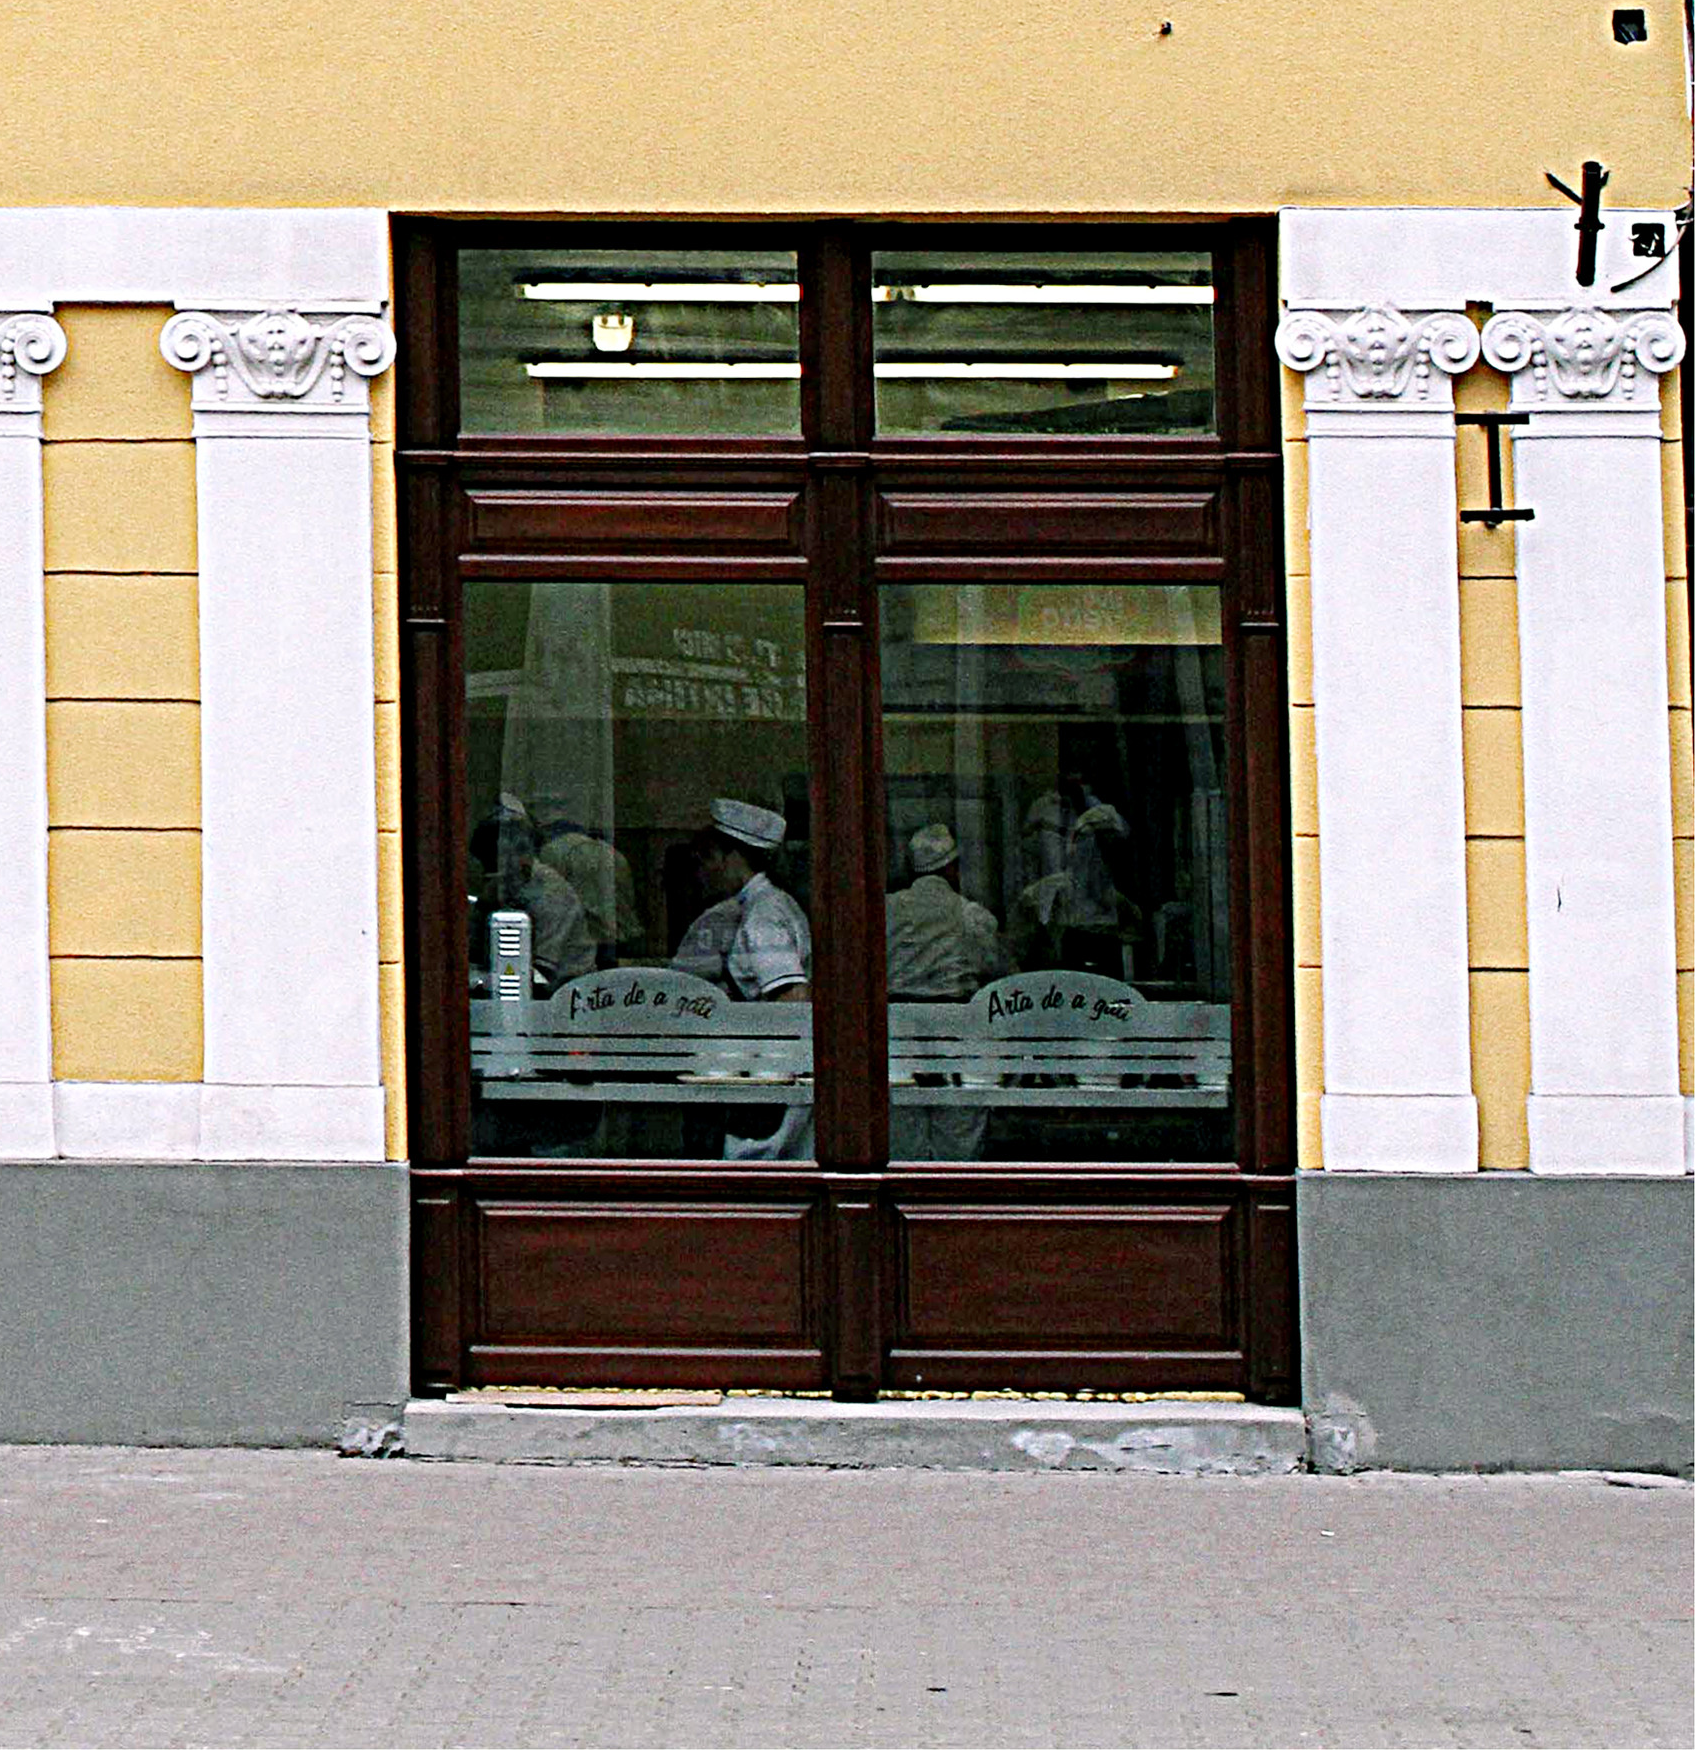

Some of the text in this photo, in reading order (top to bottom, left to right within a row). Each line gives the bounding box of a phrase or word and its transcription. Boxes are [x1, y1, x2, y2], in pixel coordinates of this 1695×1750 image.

[624, 980, 645, 1007] de
[653, 991, 668, 1006] a
[989, 990, 1034, 1024] Arta
[1041, 985, 1064, 1010] de
[1071, 993, 1086, 1009] a
